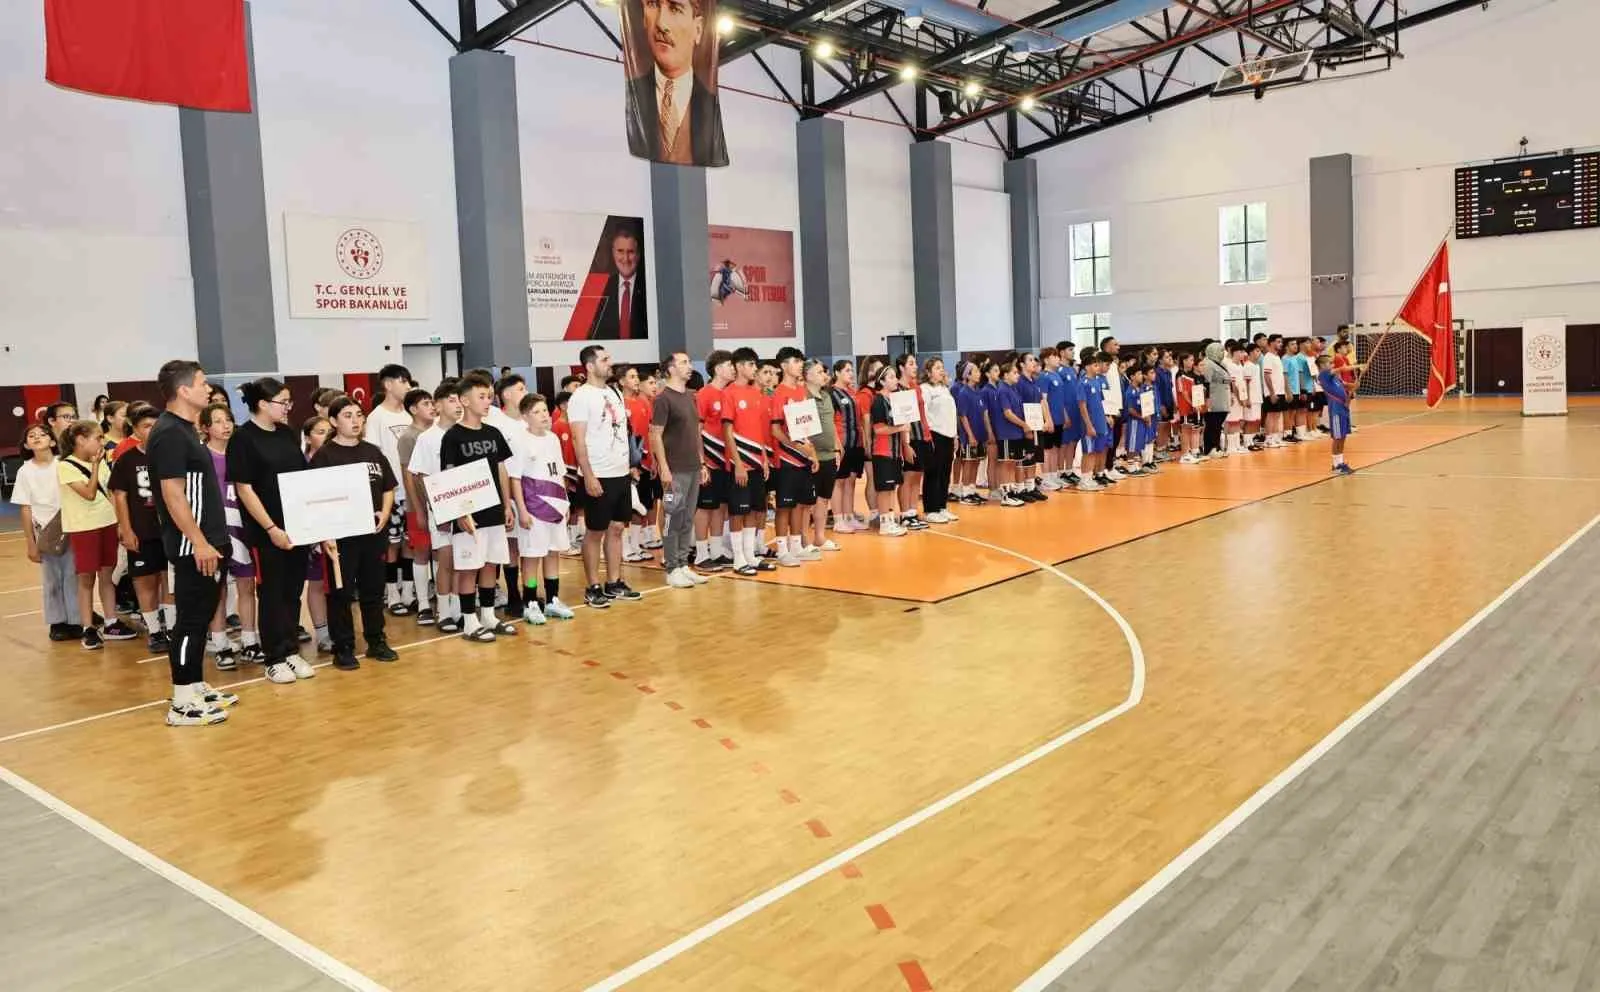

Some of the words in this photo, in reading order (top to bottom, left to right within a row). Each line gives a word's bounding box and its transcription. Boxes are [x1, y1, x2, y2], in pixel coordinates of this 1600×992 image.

[315, 284, 336, 295] T.C.
[340, 284, 389, 298] GENÇLİK
[392, 287, 407, 296] VE
[316, 298, 346, 309] SPOR
[349, 299, 408, 310] BAKANLIĞI
[547, 462, 558, 476] 14
